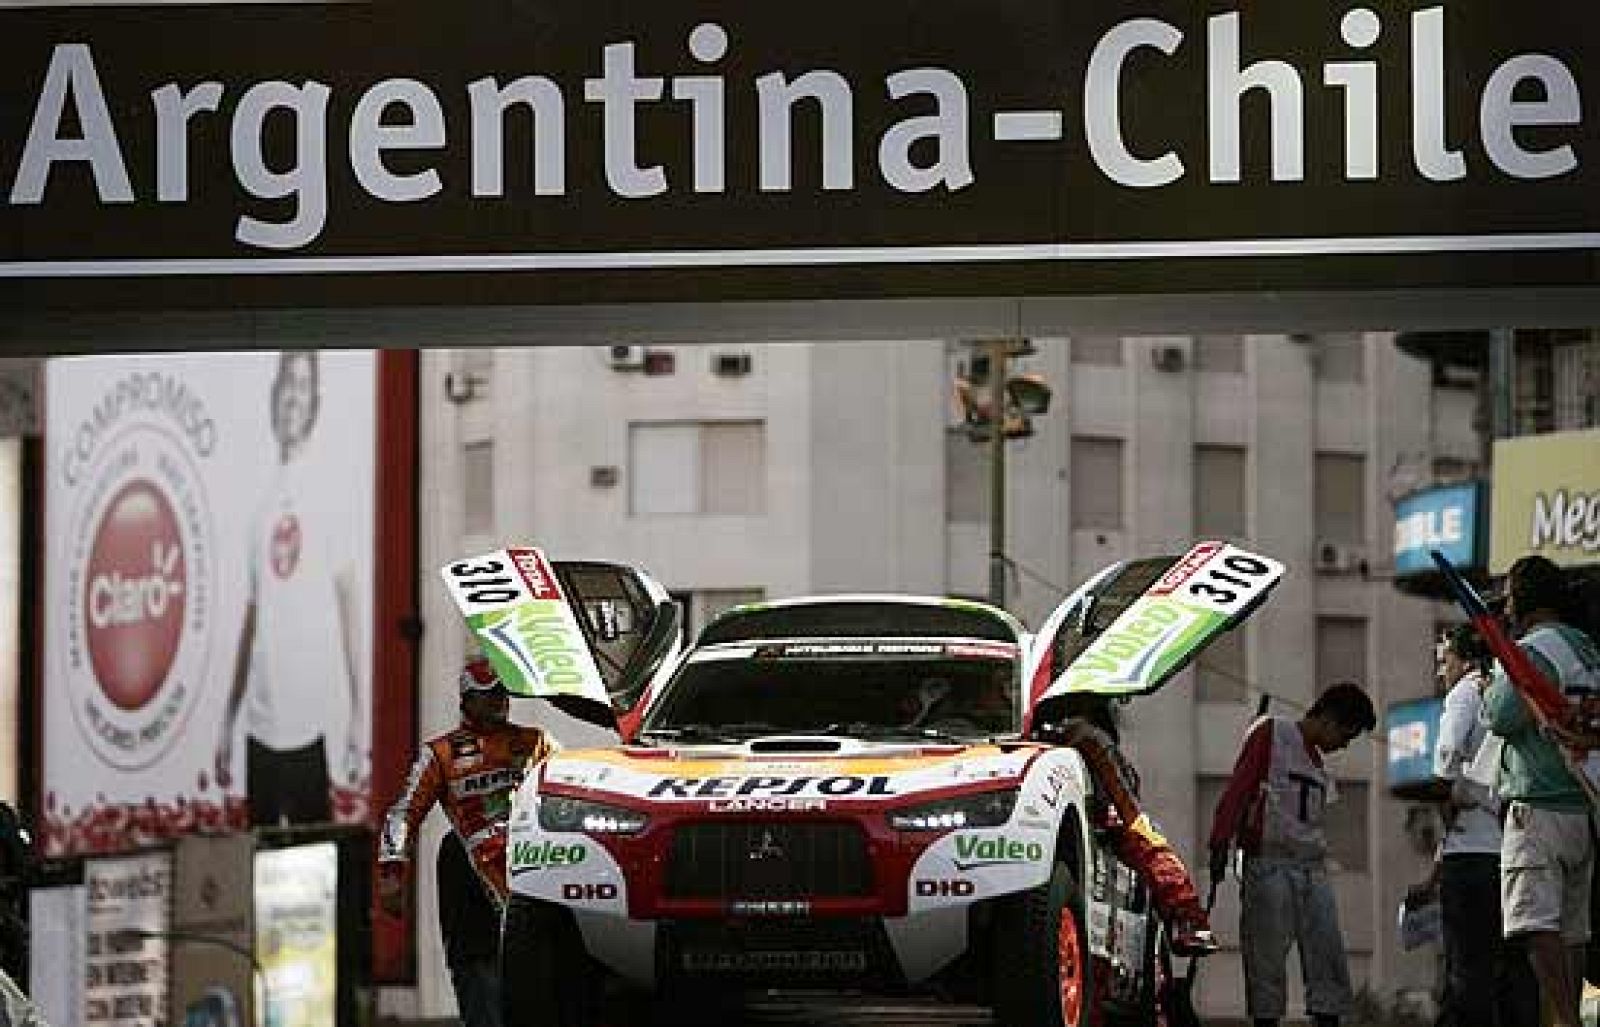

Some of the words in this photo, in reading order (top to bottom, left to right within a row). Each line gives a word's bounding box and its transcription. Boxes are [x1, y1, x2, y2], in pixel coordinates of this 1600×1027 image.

[10, 6, 1581, 248] Argentina-Chile
[90, 570, 176, 629] Claro
[451, 561, 519, 603] 310
[1190, 556, 1269, 602] 310
[648, 776, 897, 798] REPSOL
[511, 841, 587, 865] Valeo
[953, 834, 1043, 861] Valeo
